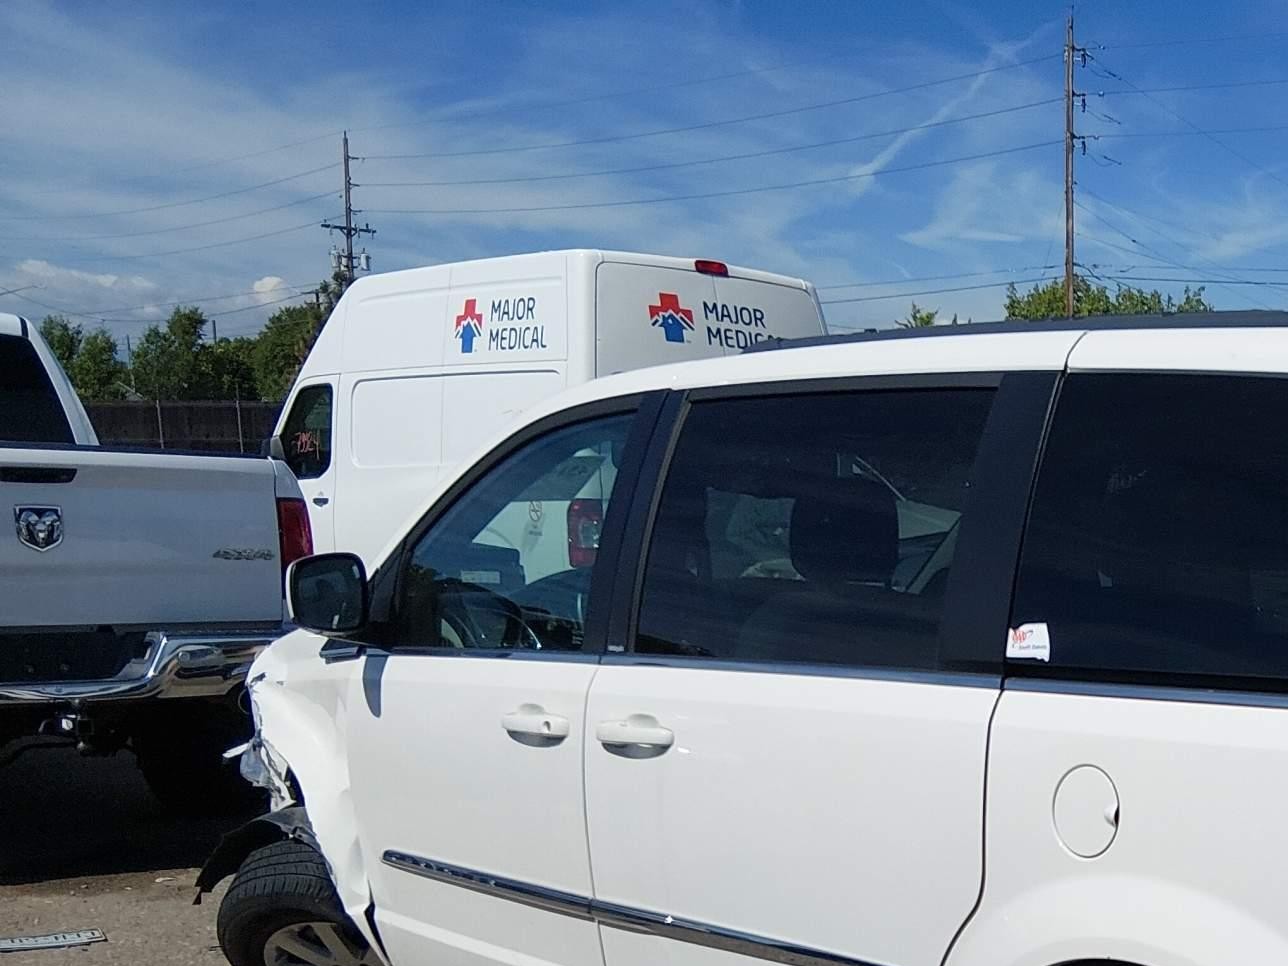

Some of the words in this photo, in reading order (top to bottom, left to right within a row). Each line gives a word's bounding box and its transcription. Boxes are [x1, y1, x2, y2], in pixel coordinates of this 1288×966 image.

[490, 297, 536, 322] MAJOR
[703, 301, 766, 329] MAJOR
[488, 326, 547, 351] MEDICAL
